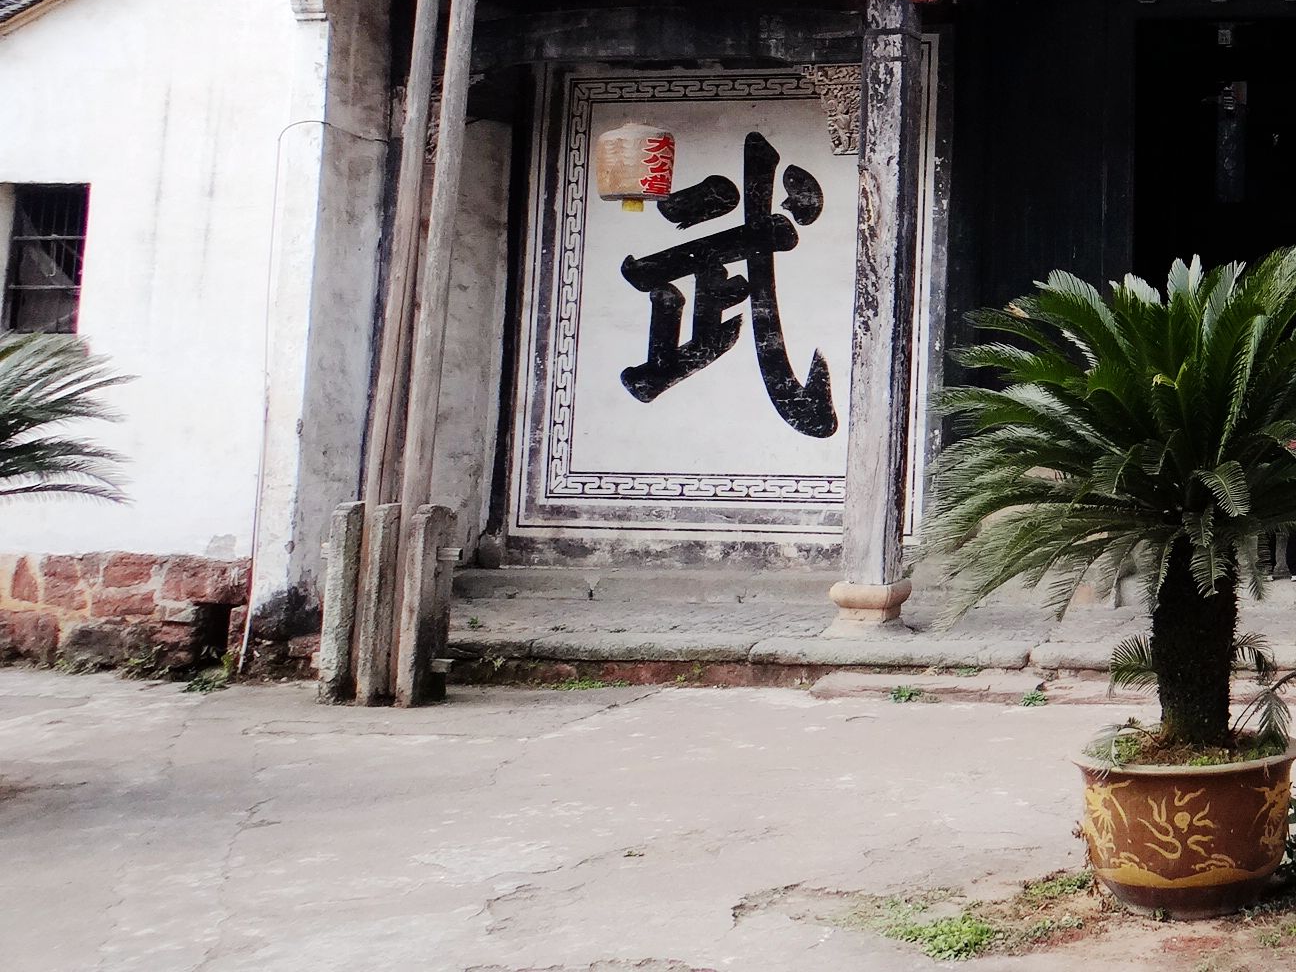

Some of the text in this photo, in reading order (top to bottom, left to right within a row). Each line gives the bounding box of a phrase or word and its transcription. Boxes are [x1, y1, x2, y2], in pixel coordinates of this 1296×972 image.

[640, 135, 676, 196] 大公堂
[620, 131, 839, 439] 武
